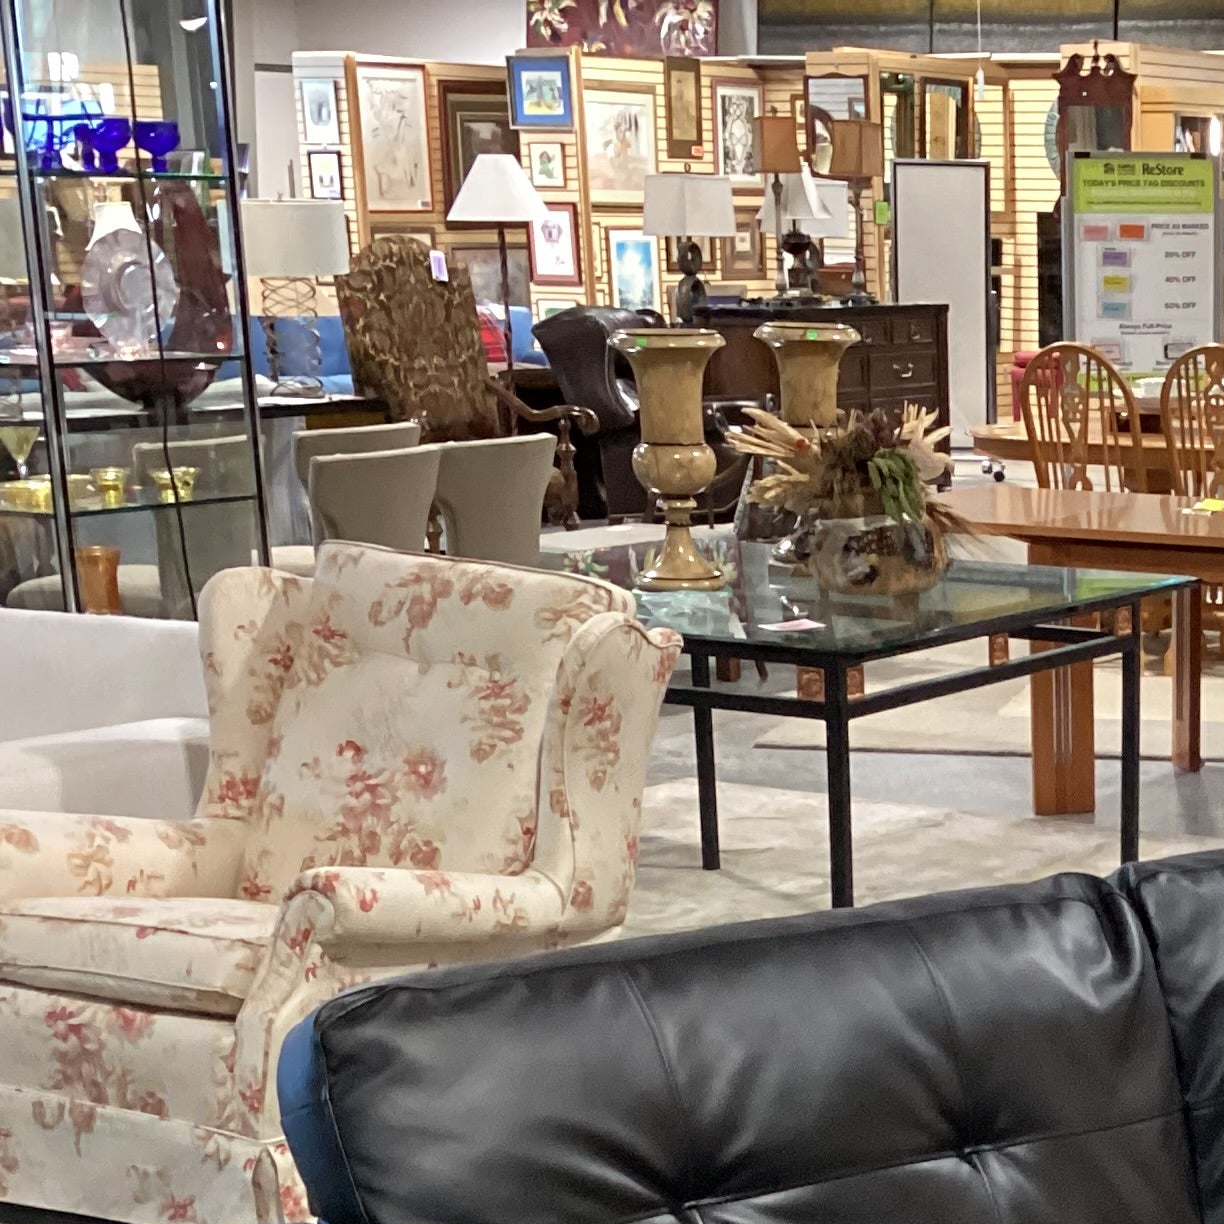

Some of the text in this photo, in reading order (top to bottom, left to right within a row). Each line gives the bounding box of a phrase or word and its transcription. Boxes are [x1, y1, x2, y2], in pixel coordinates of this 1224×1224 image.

[1142, 163, 1184, 175] ReStore
[1118, 179, 1141, 187] PRICE
[1143, 179, 1159, 187] TAG
